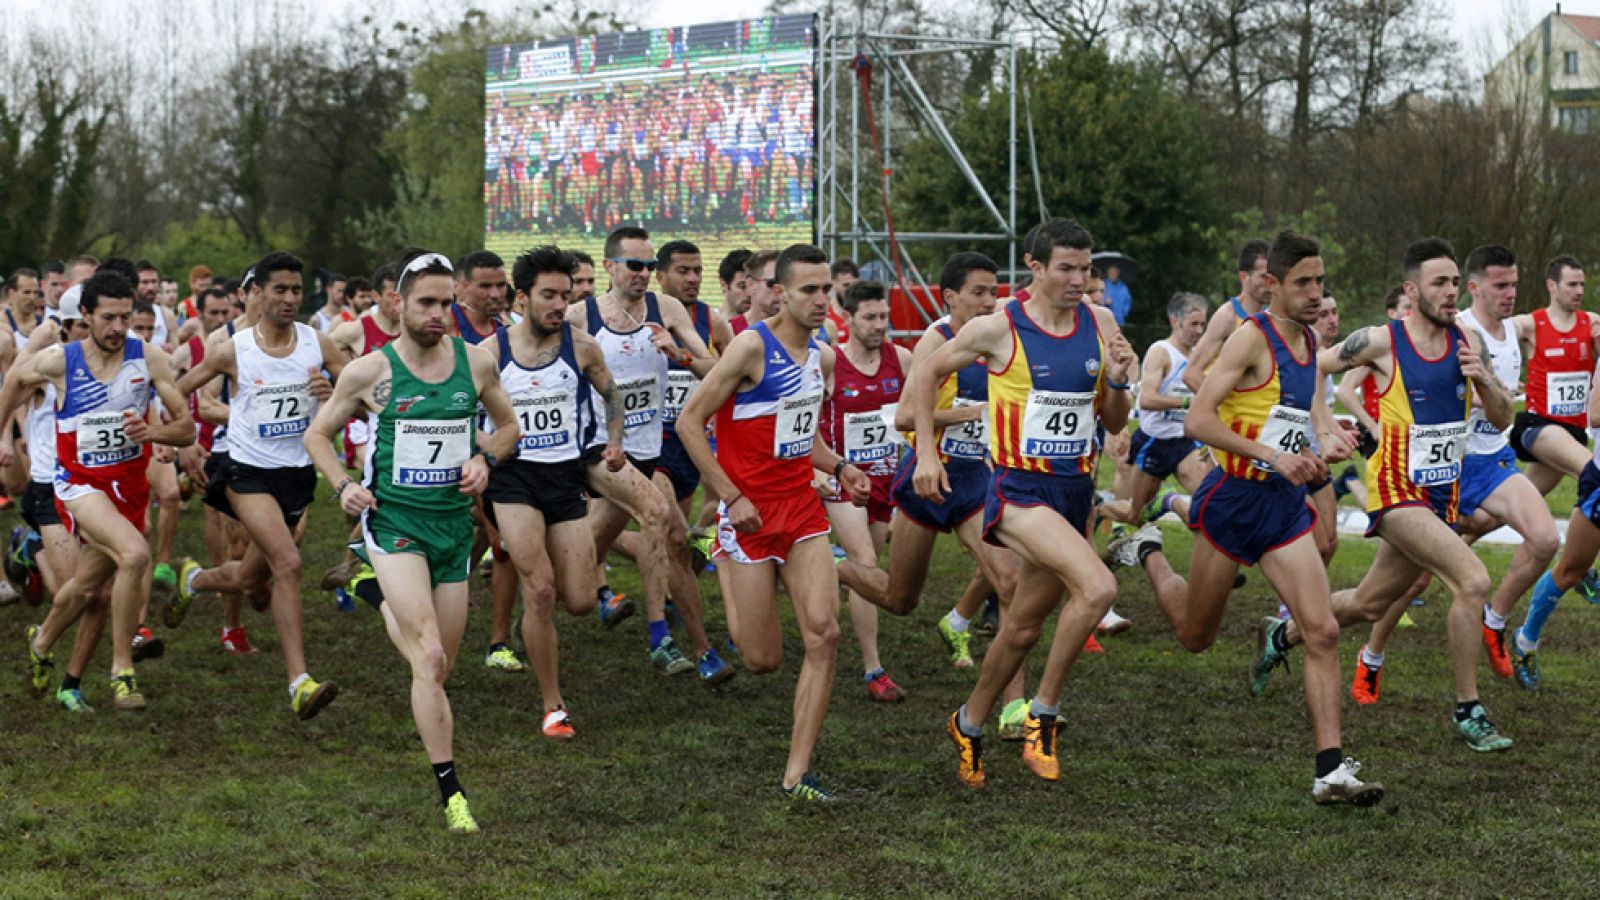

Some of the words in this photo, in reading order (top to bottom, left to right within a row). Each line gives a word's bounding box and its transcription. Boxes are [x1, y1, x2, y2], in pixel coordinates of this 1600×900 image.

[624, 391, 650, 410] 03
[1557, 385, 1585, 400] 128
[270, 397, 299, 418] 72
[264, 420, 306, 436] Joma
[402, 424, 467, 435] BRIDGESTONE
[520, 408, 562, 431] 109
[792, 412, 813, 435] 42
[1045, 412, 1078, 436] 49
[97, 428, 127, 449] 35
[863, 426, 887, 445] 57
[1279, 429, 1304, 454] 48
[427, 440, 443, 464] 7
[1032, 442, 1080, 455] Joma
[1429, 440, 1455, 463] 50
[404, 470, 457, 483] Joma
